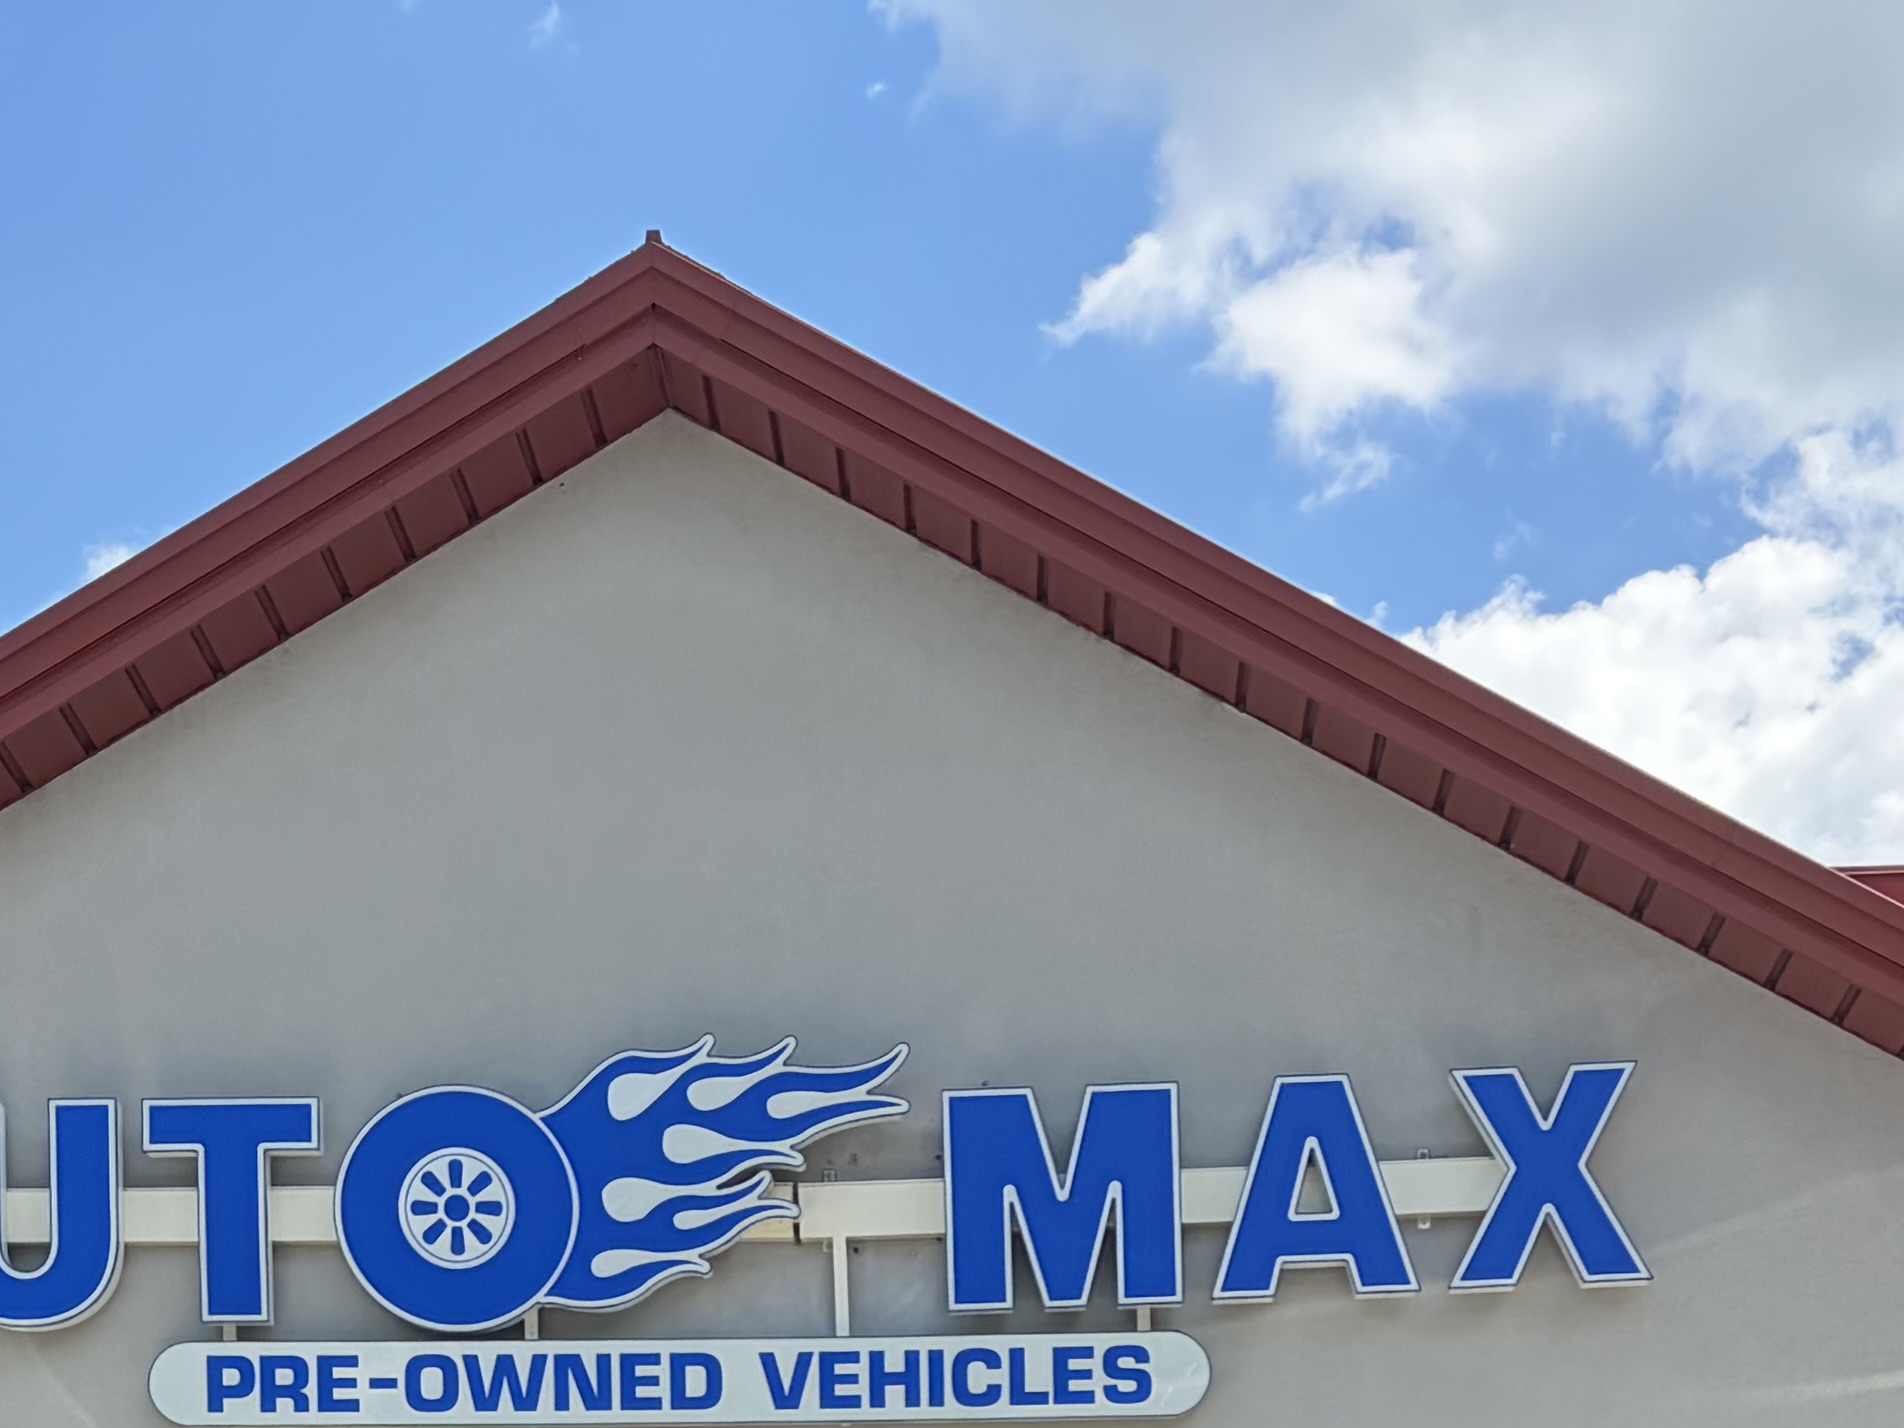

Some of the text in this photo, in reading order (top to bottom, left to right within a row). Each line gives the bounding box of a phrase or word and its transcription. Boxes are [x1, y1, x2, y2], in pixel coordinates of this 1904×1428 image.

[942, 1061, 1651, 1311] MAX
[207, 1345, 1151, 1413] PRE-OWNED VEHICLES
